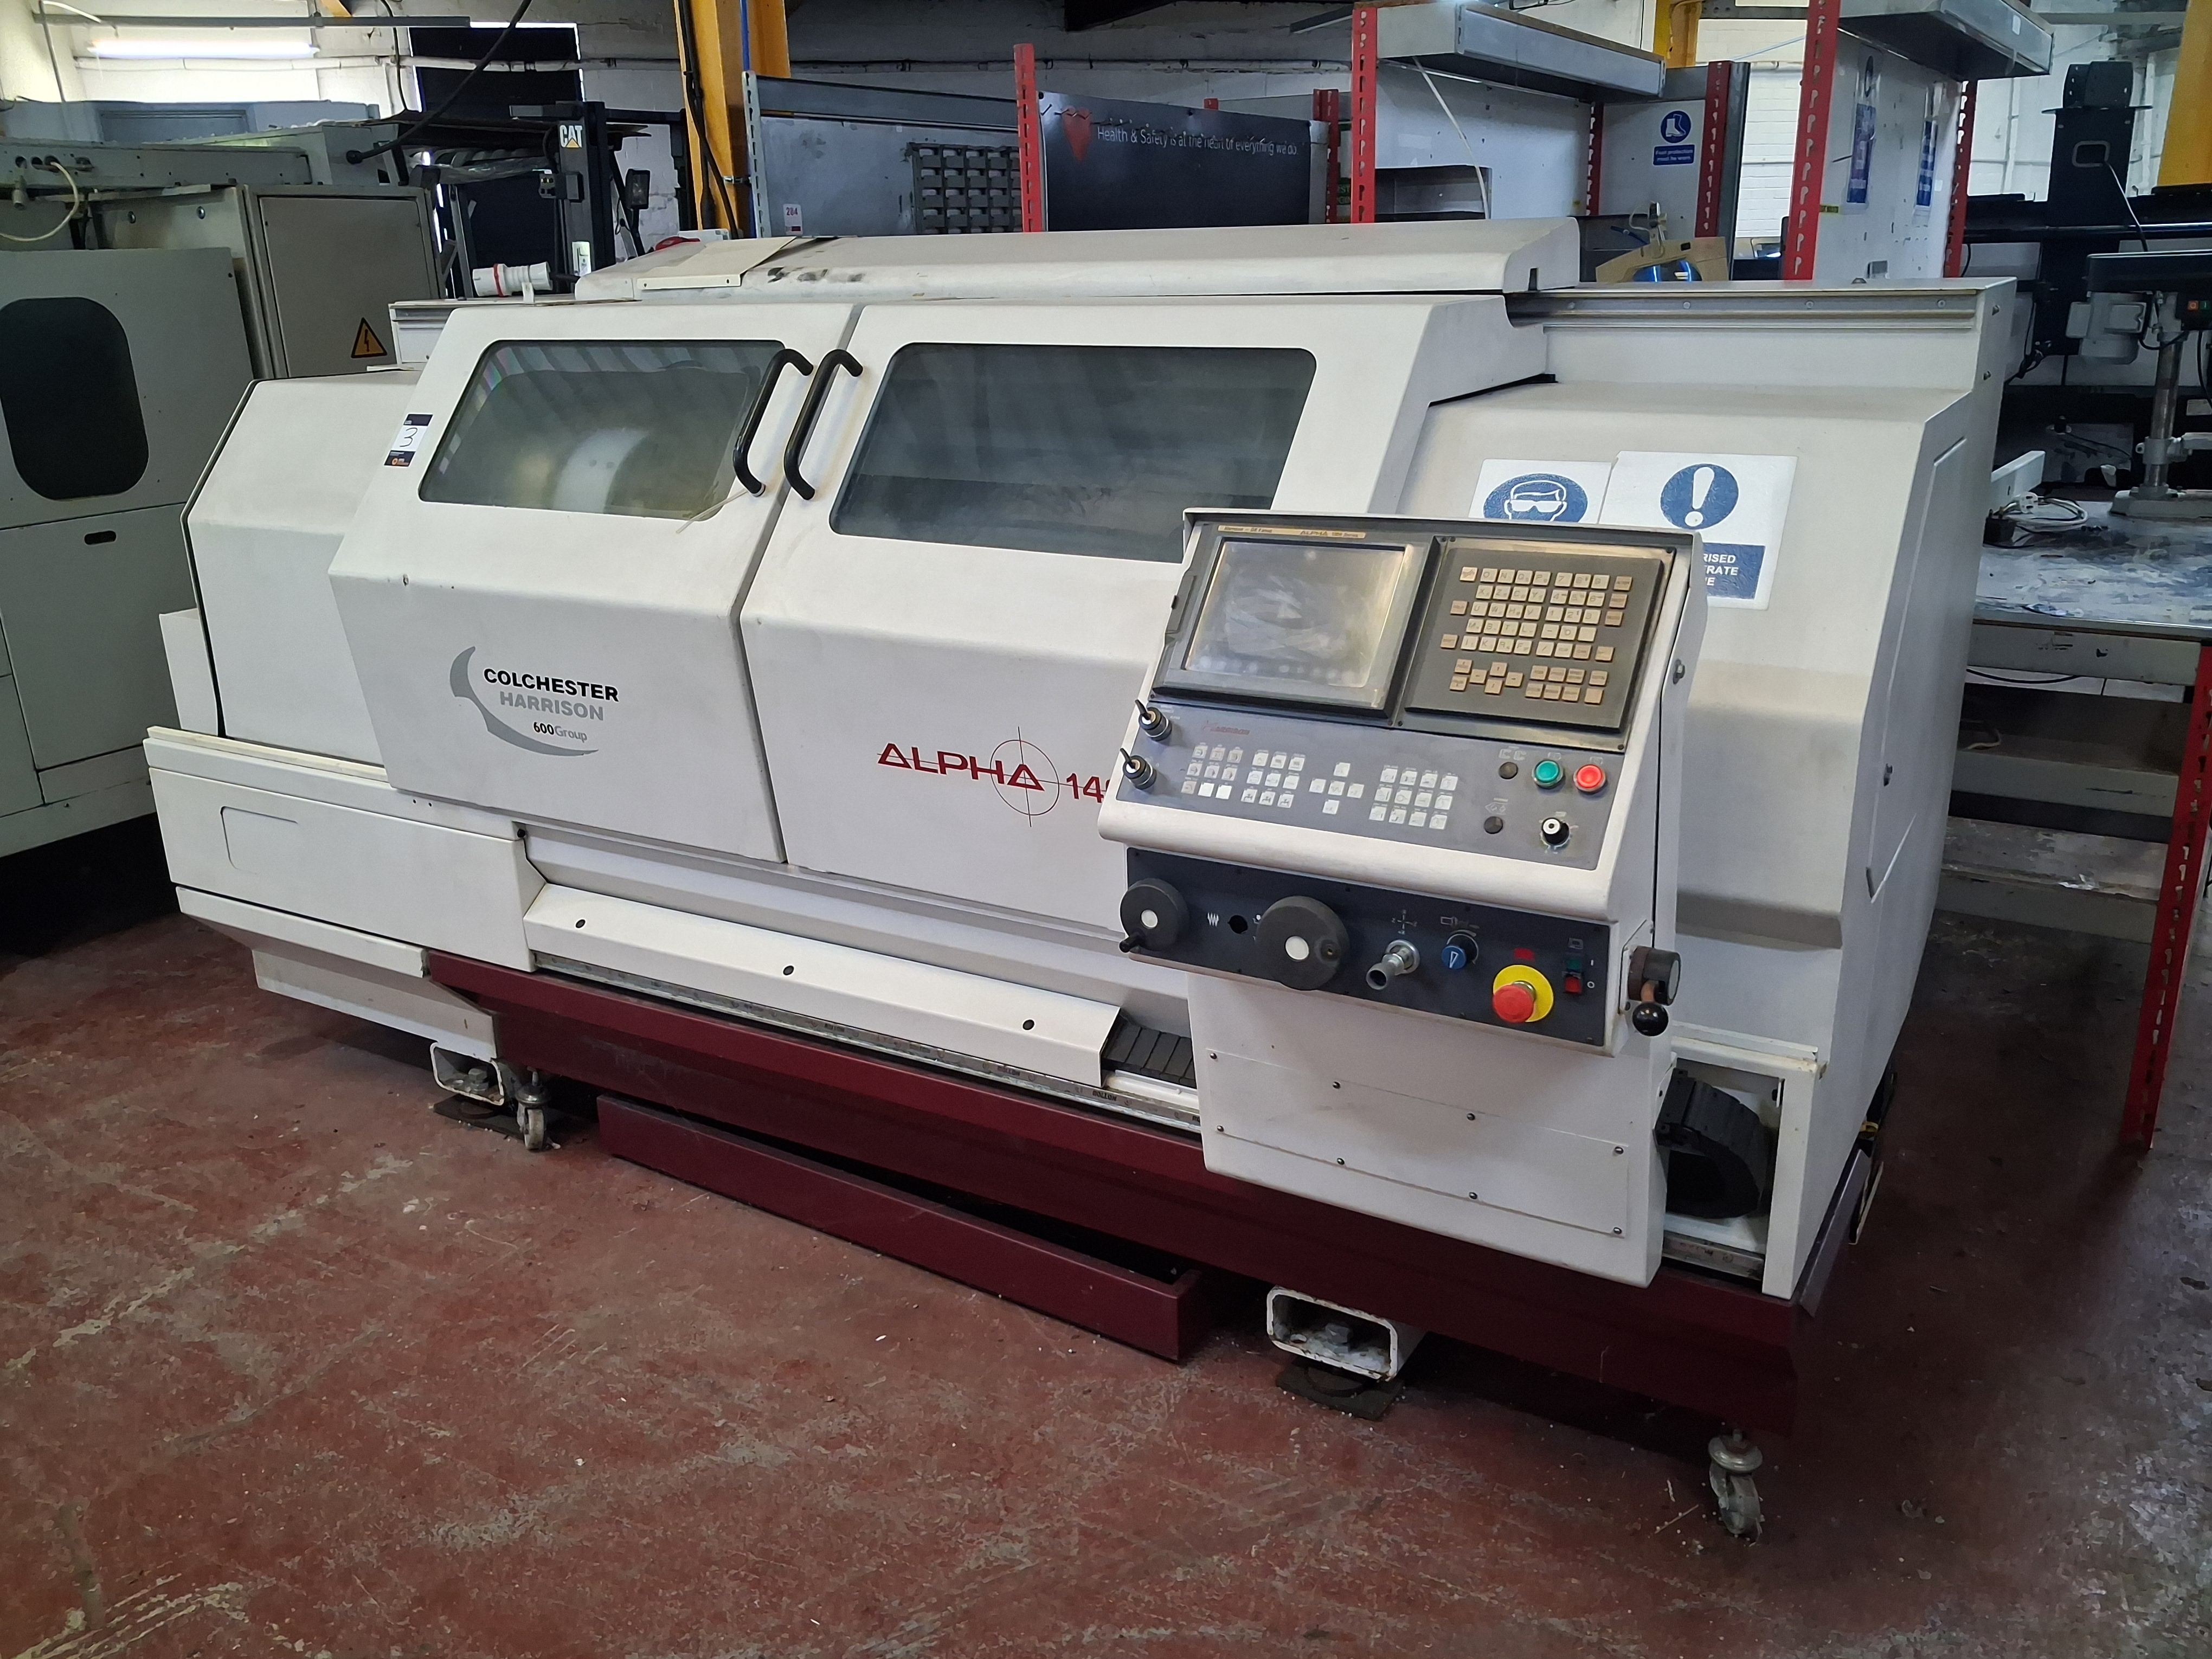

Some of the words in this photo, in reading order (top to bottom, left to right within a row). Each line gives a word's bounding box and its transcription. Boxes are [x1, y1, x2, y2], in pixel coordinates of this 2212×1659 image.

[560, 125, 583, 147] CAT
[1098, 126, 1128, 142] Health
[1130, 128, 1137, 143] &
[1141, 129, 1167, 148] Safety
[400, 427, 417, 447] 3
[1704, 565, 1739, 575] RATE
[484, 668, 619, 702] COLCHESTER
[499, 691, 604, 721] HARRISON
[877, 743, 1045, 792] ALPHA
[1066, 773, 1110, 803] 14
